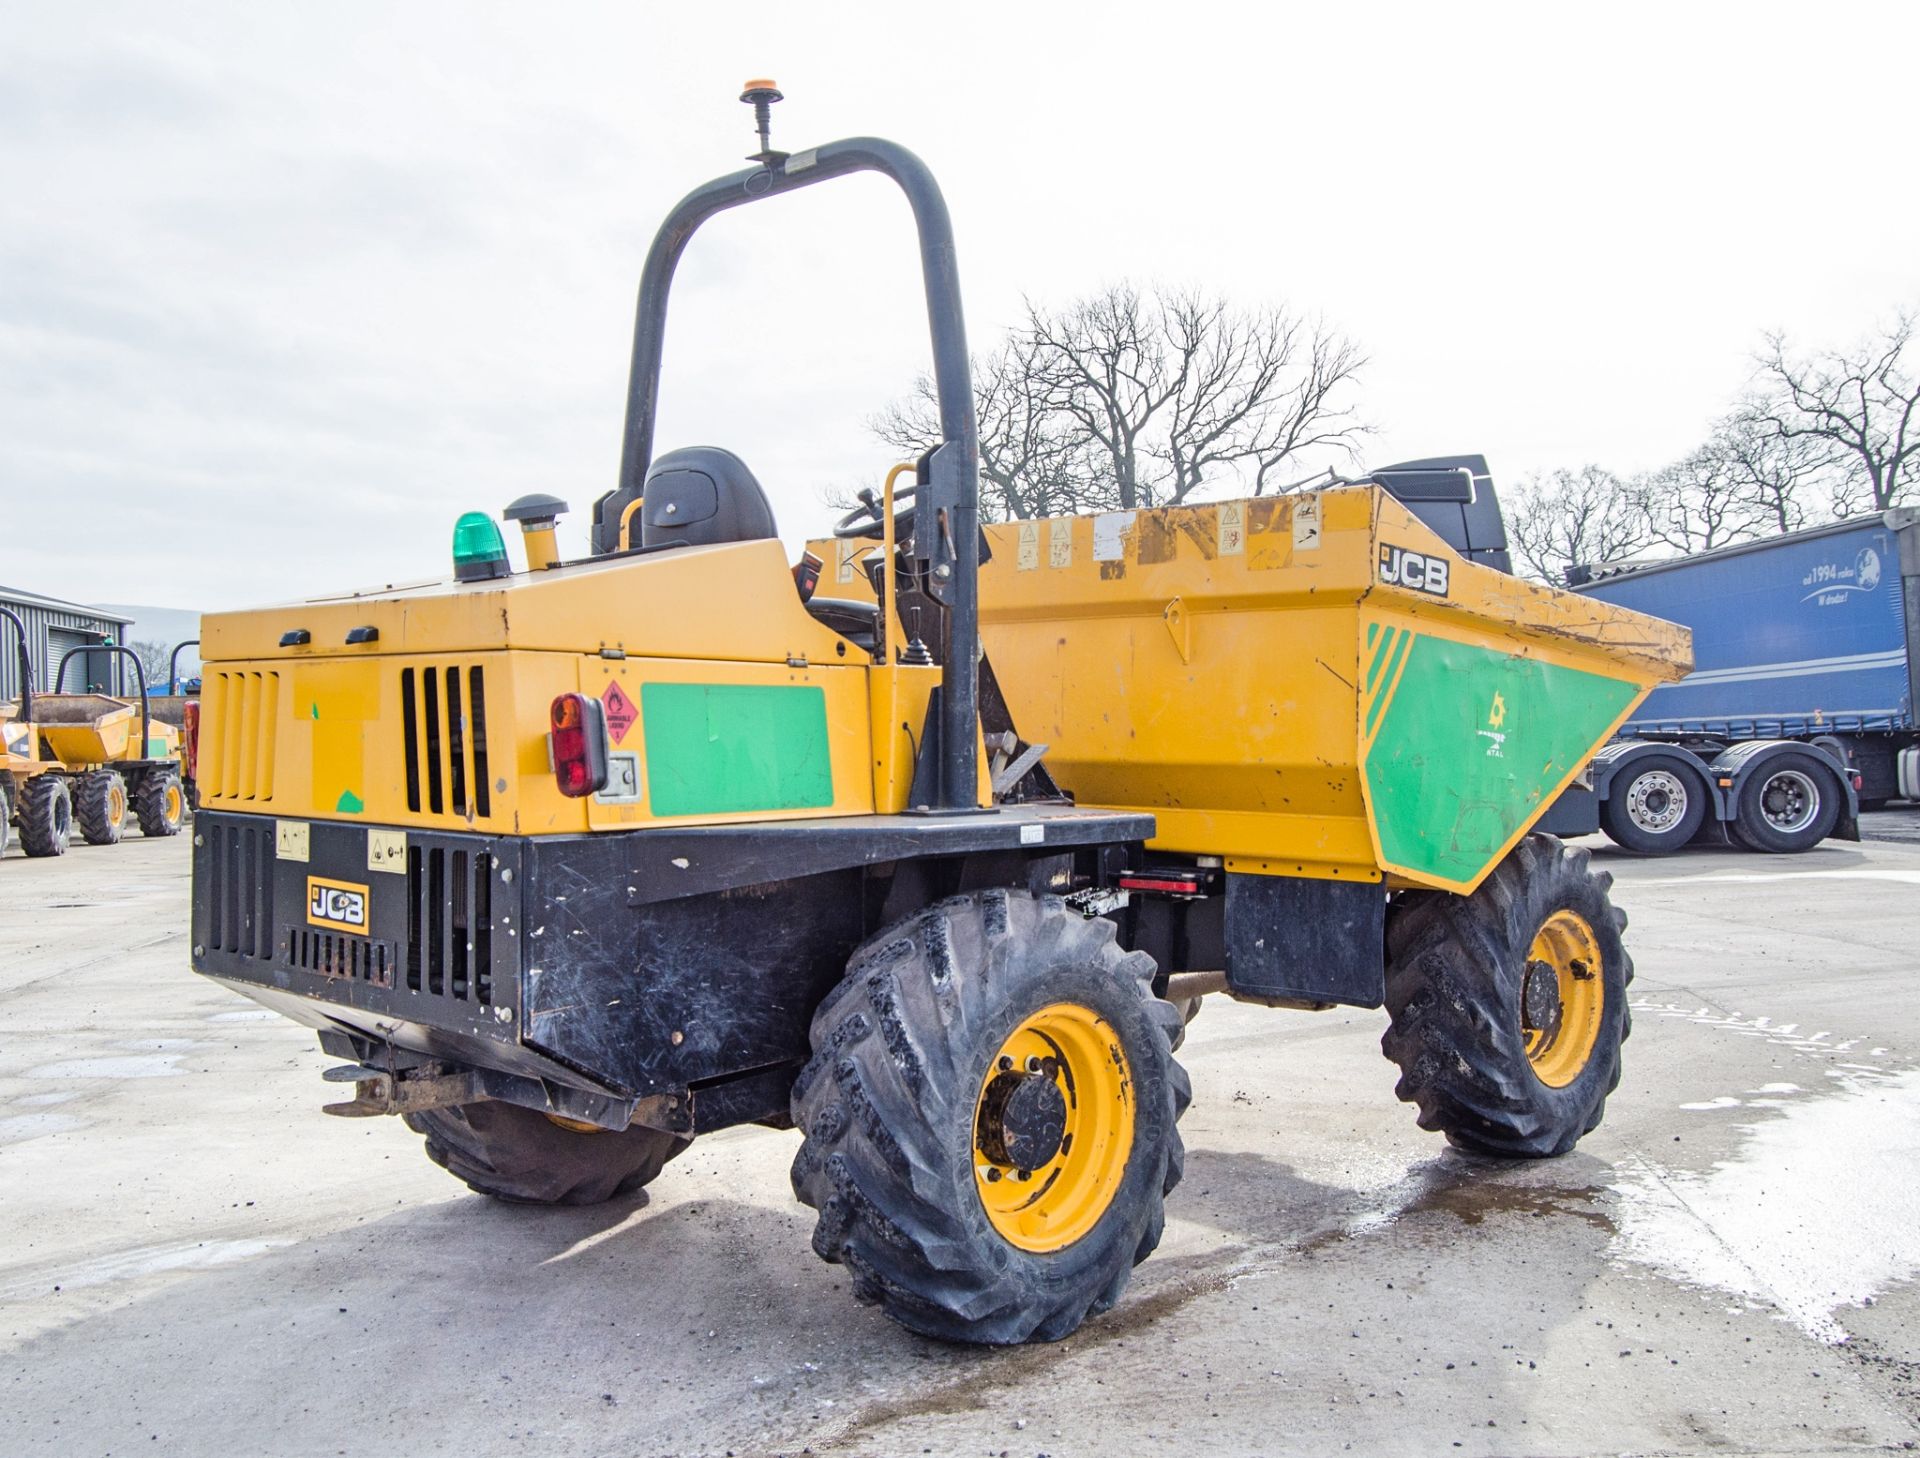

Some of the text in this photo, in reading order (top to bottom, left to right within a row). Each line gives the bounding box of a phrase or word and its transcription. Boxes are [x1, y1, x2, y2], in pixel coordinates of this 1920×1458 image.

[1380, 548, 1448, 594] JCB
[1812, 564, 1836, 583] 1994
[312, 887, 364, 924] JCB
